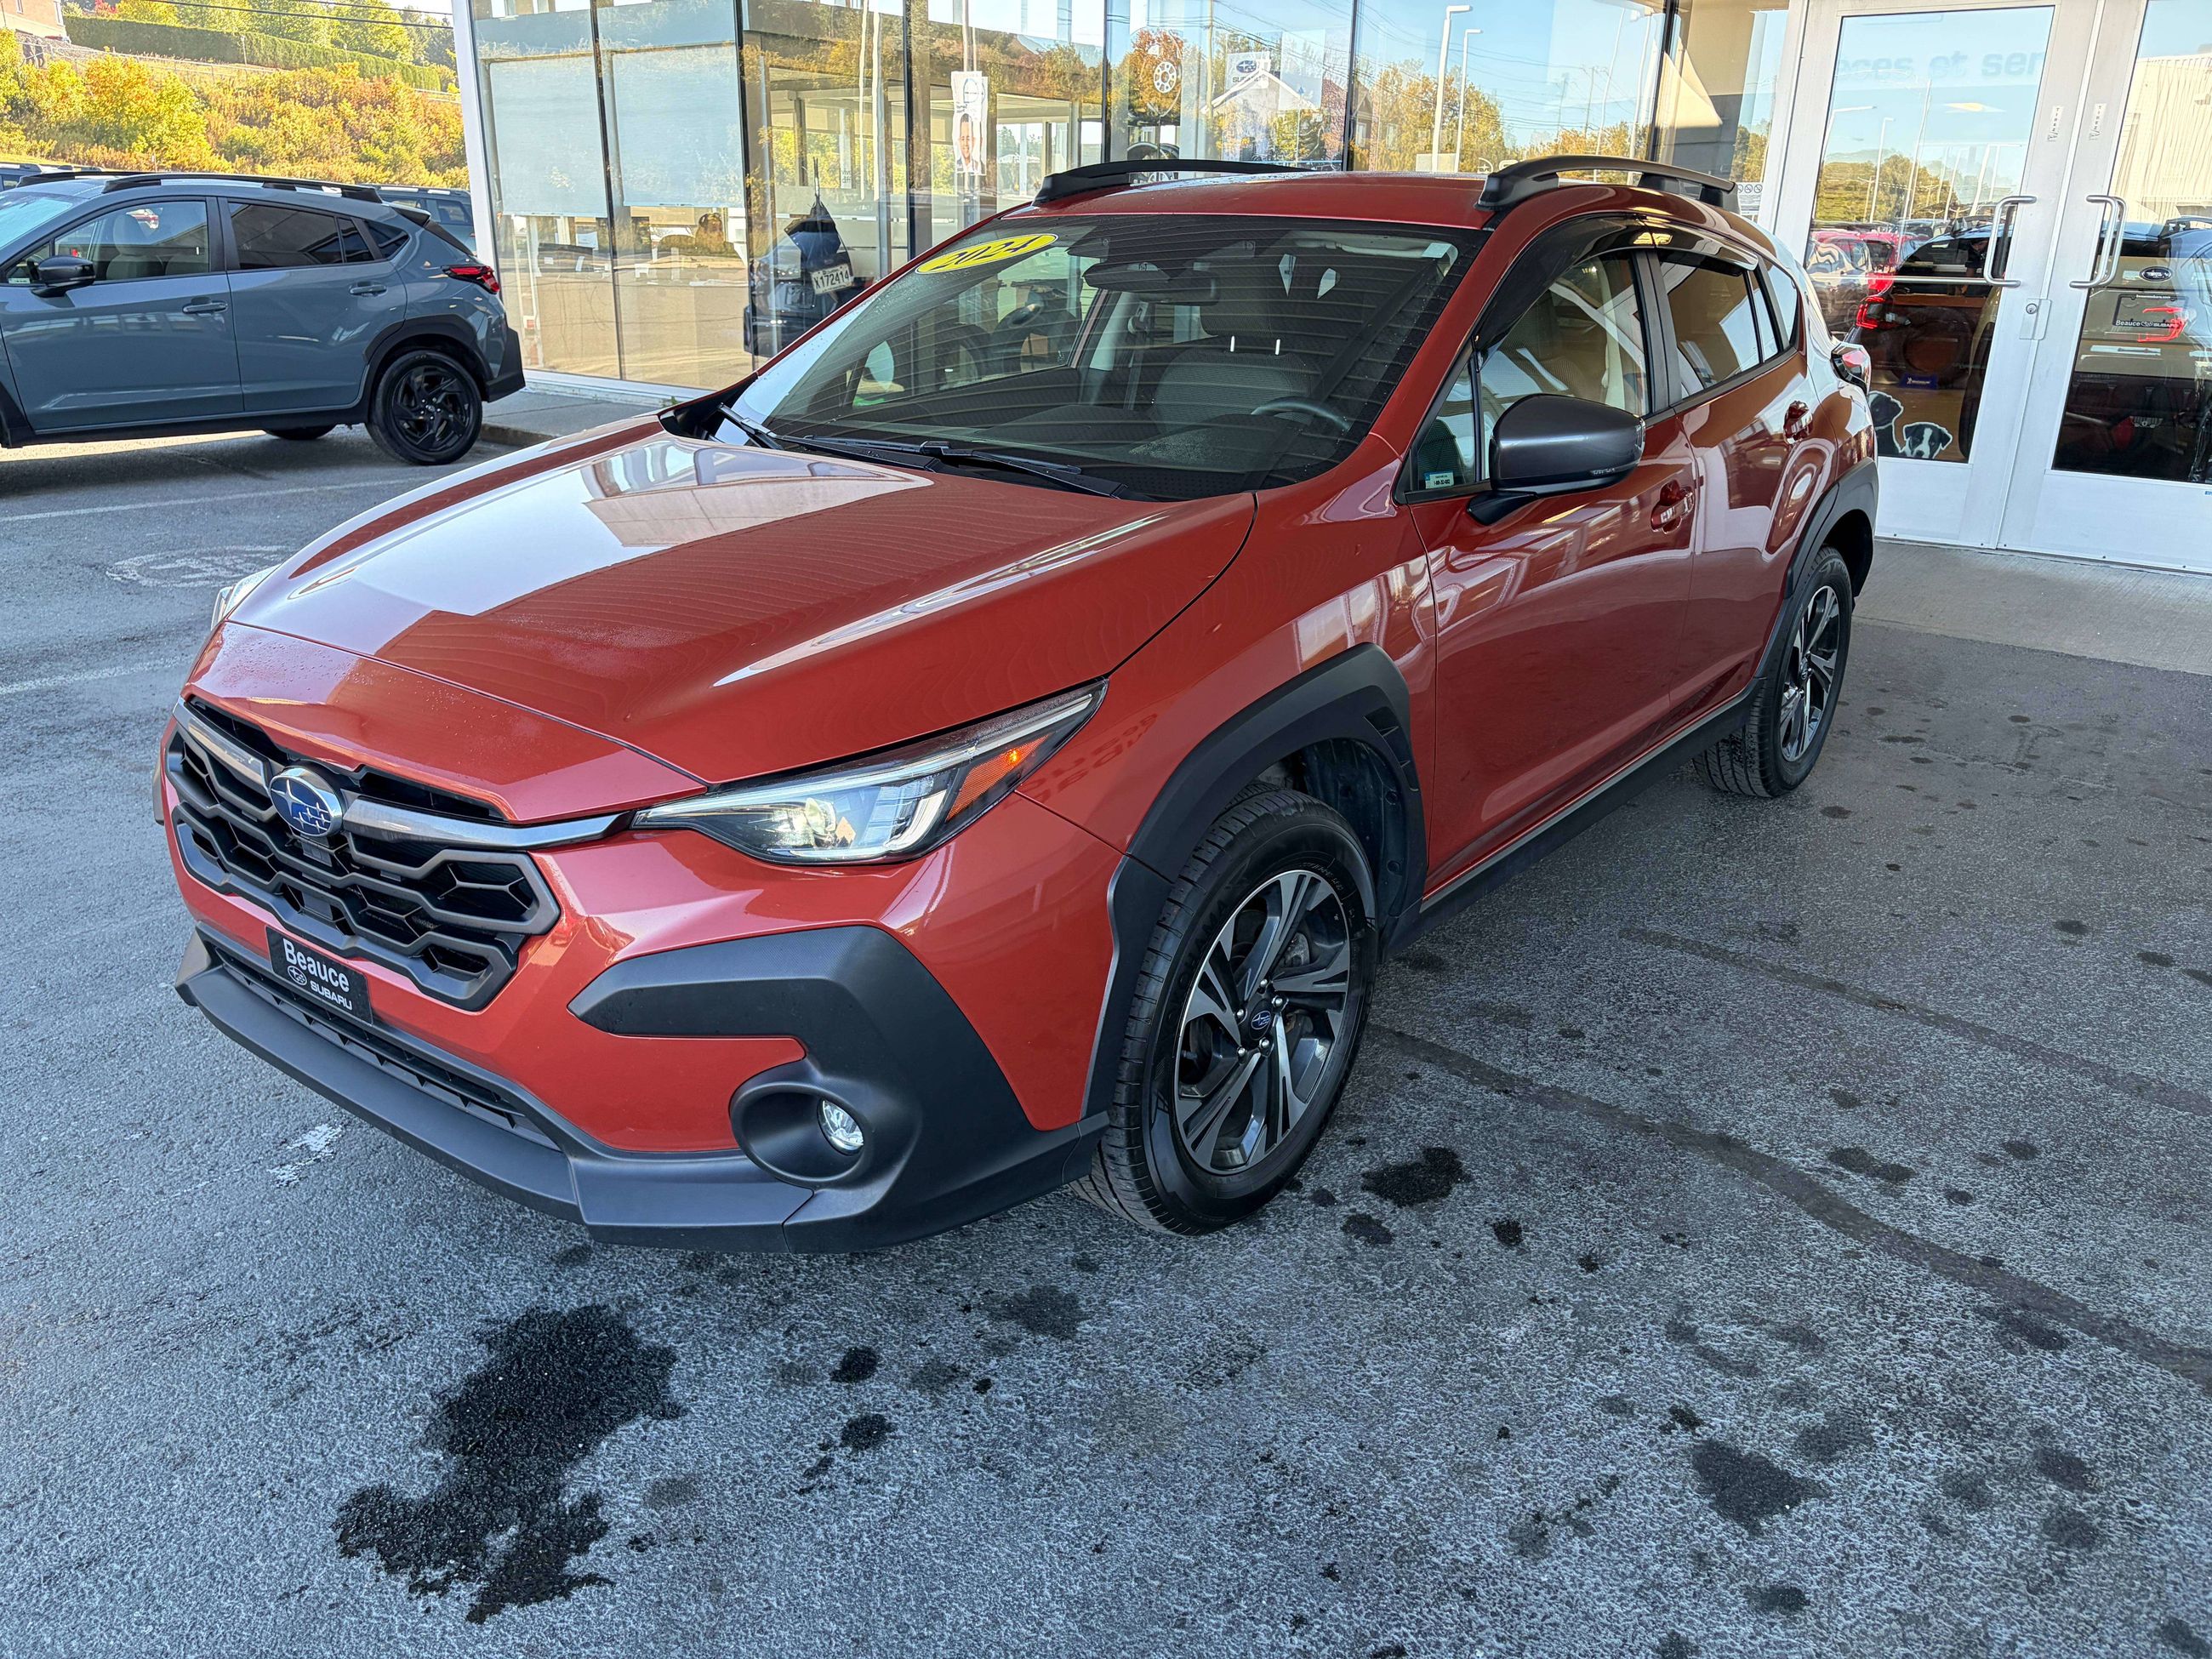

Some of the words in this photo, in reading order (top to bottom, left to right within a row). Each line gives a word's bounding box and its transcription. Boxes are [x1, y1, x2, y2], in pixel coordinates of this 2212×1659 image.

[928, 235, 1043, 271] 2024
[813, 270, 849, 288] X172414
[282, 938, 350, 993] Beauce
[310, 980, 353, 1011] SUBARU
